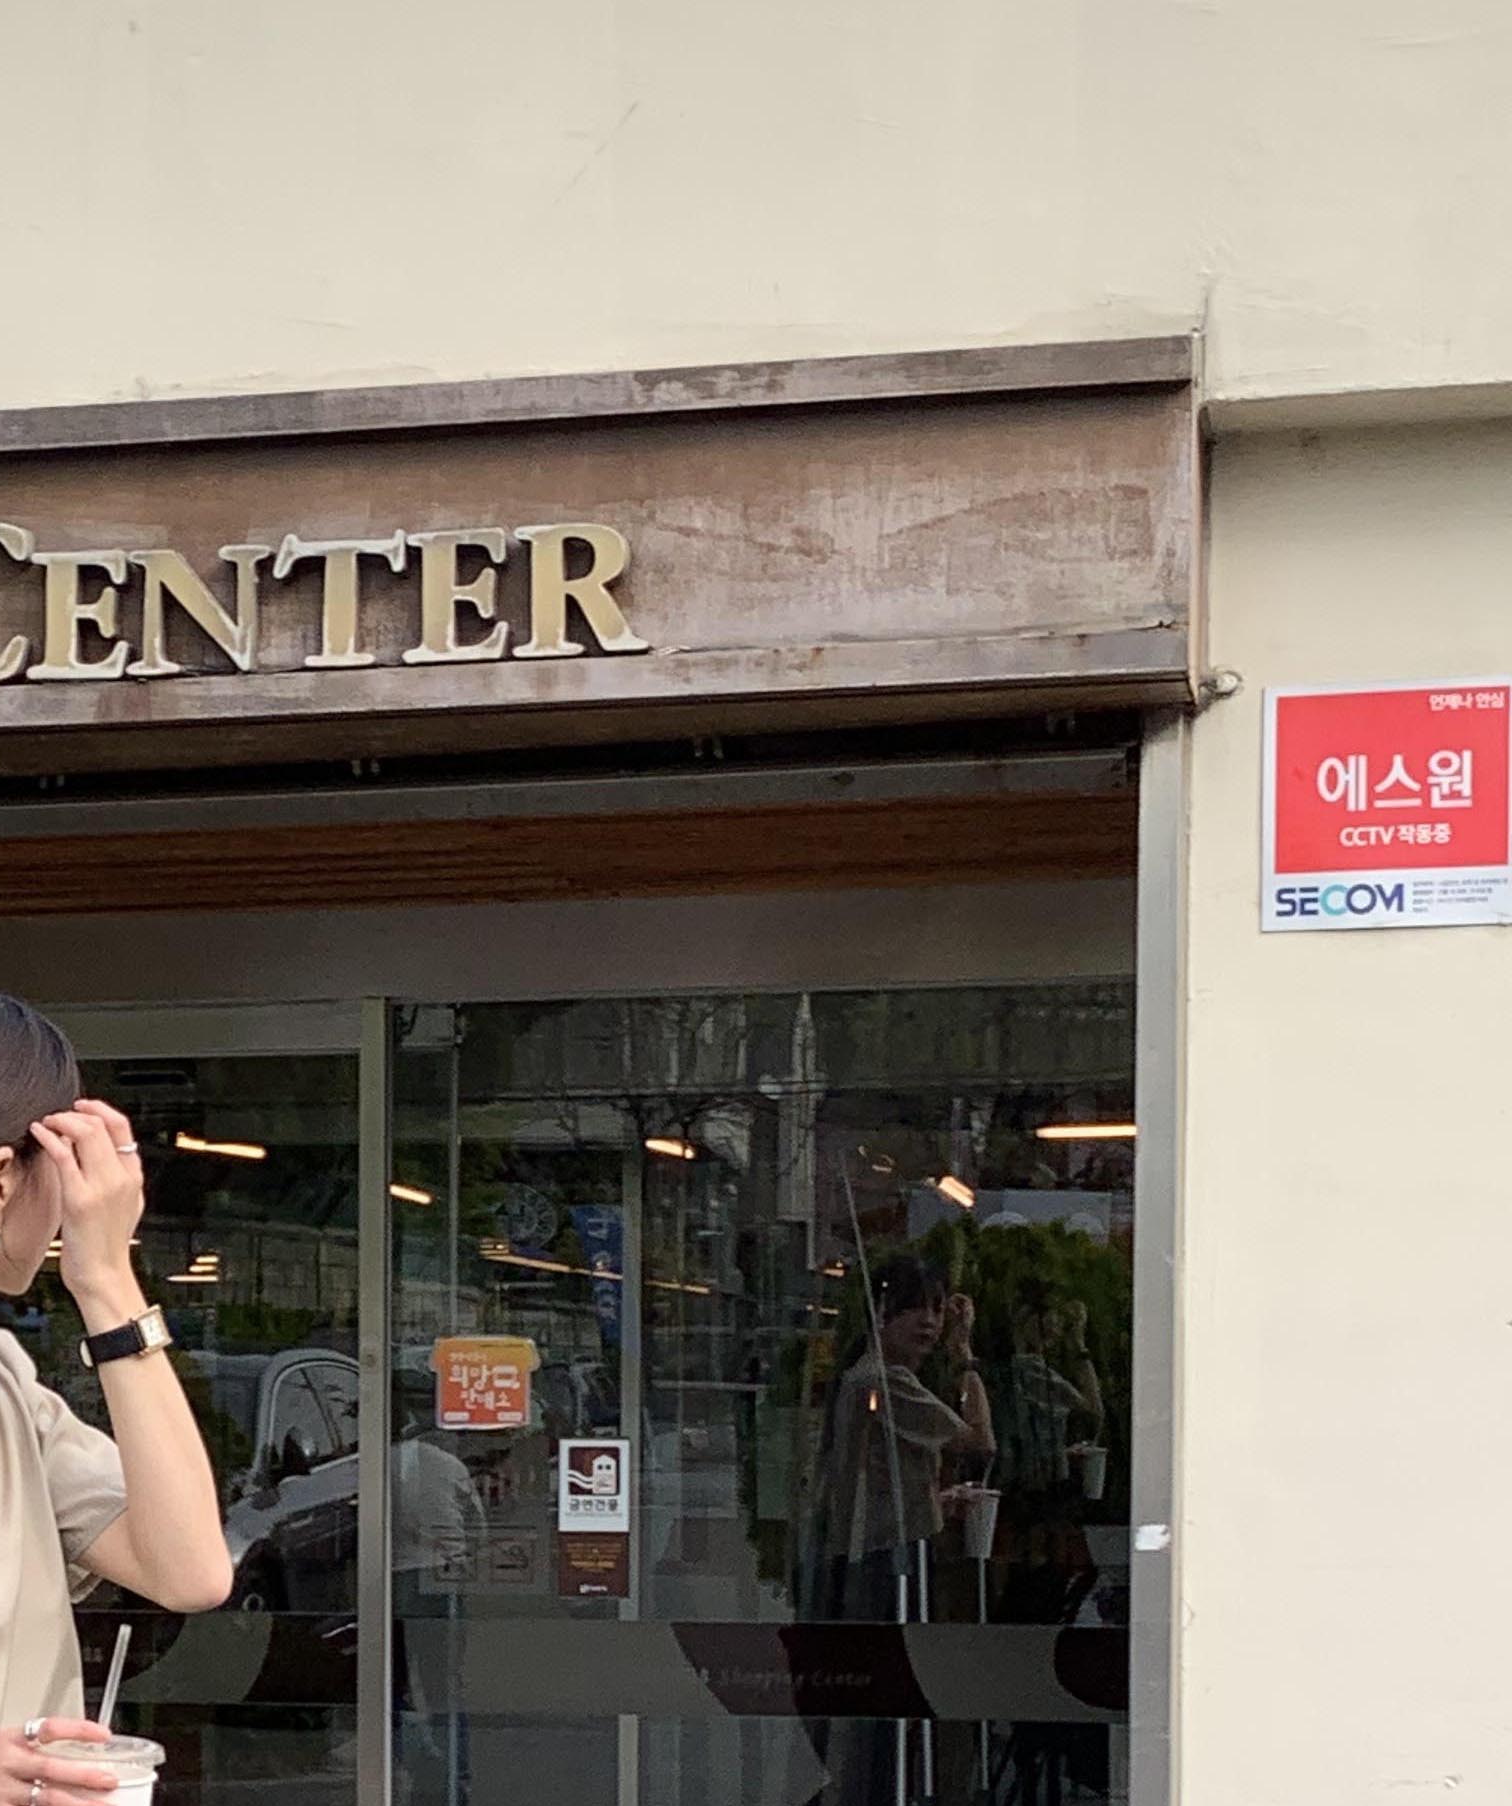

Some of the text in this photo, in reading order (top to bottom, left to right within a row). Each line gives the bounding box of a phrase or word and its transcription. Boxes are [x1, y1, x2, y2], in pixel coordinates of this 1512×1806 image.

[1316, 749, 1473, 812] 에스원
[1339, 823, 1452, 847] CCTV 작동중
[1275, 883, 1405, 917] SECOM
